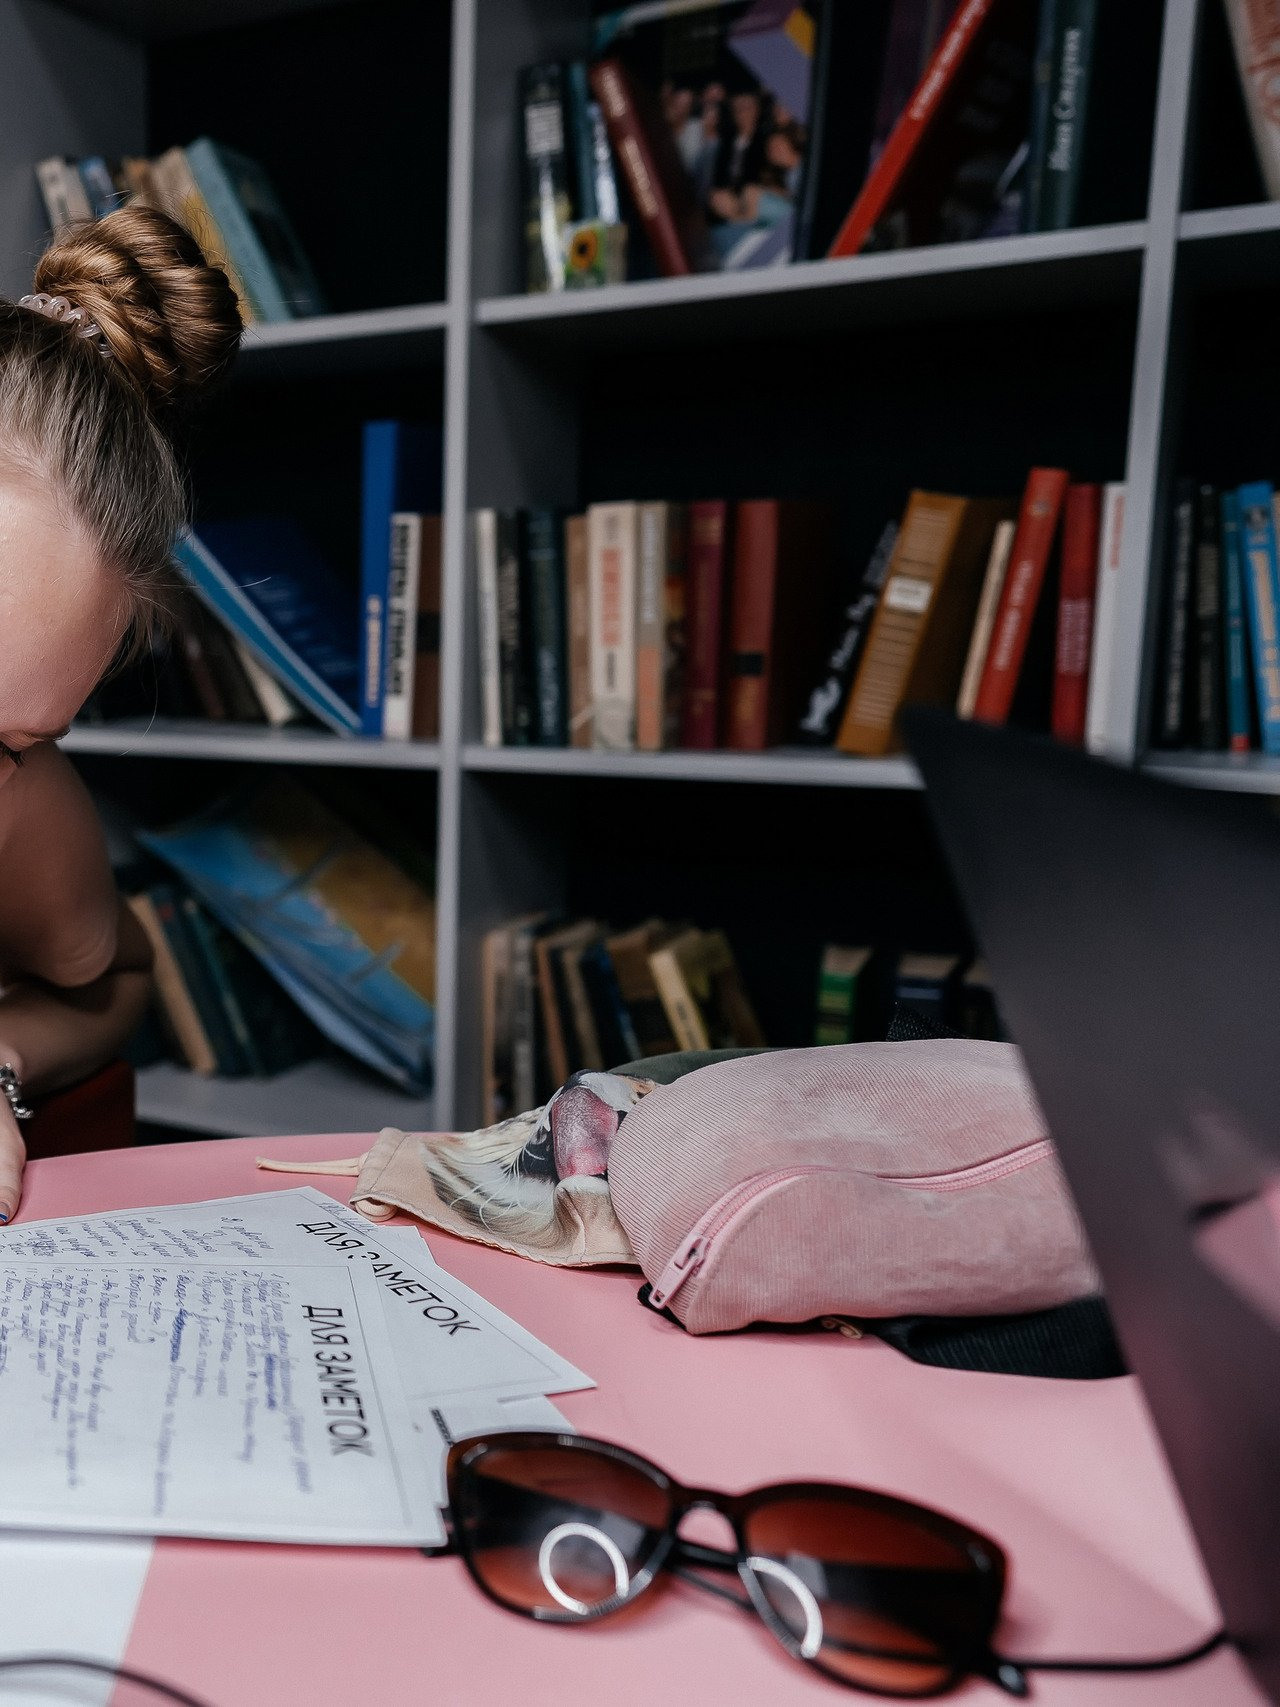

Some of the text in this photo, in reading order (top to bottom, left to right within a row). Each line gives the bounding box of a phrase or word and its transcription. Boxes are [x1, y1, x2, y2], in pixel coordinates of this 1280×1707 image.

[296, 1221, 365, 1251] ДЛЯ
[301, 1304, 375, 1458] ДЛЯ ЗАМЕТОК
